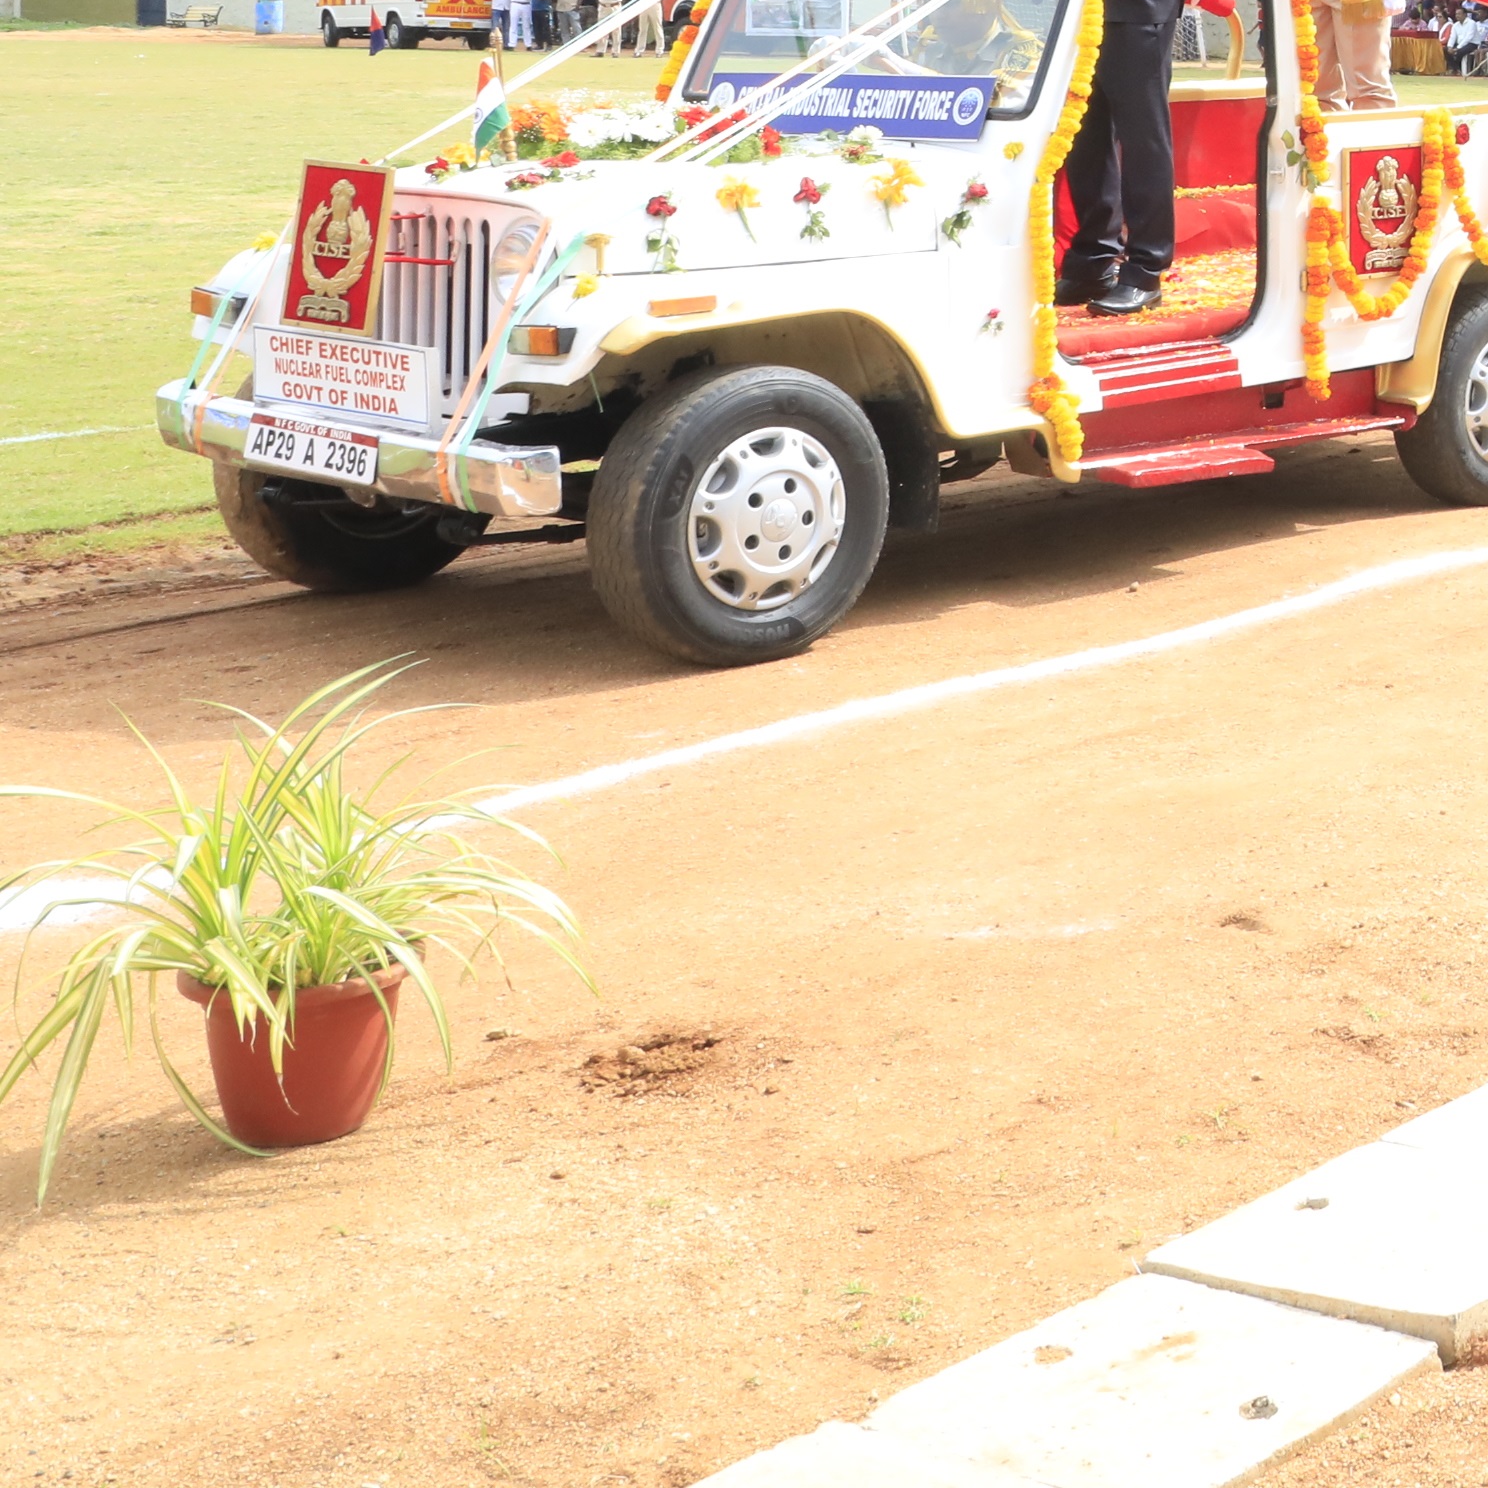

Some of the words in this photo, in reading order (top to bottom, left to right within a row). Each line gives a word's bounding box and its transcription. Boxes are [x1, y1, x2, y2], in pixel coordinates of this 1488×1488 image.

[436, 5, 491, 14] AMBULANCE
[781, 87, 854, 117] NDUSTRIAL
[852, 89, 913, 120] SECURITY
[910, 90, 954, 121] FORCE
[270, 335, 313, 355] CHIEF
[319, 342, 410, 372] EXECUTIVE
[275, 357, 322, 379] NUCLEAR
[325, 364, 351, 384] FUEL
[354, 369, 406, 392] COMPLEX
[282, 381, 323, 402] GOVT
[328, 388, 348, 406] OF
[354, 392, 399, 415] INDIA
[317, 426, 328, 436] OF
[329, 428, 352, 441] INDIA
[251, 427, 295, 461] AP29
[302, 438, 314, 466] A
[323, 441, 368, 477] 2396
